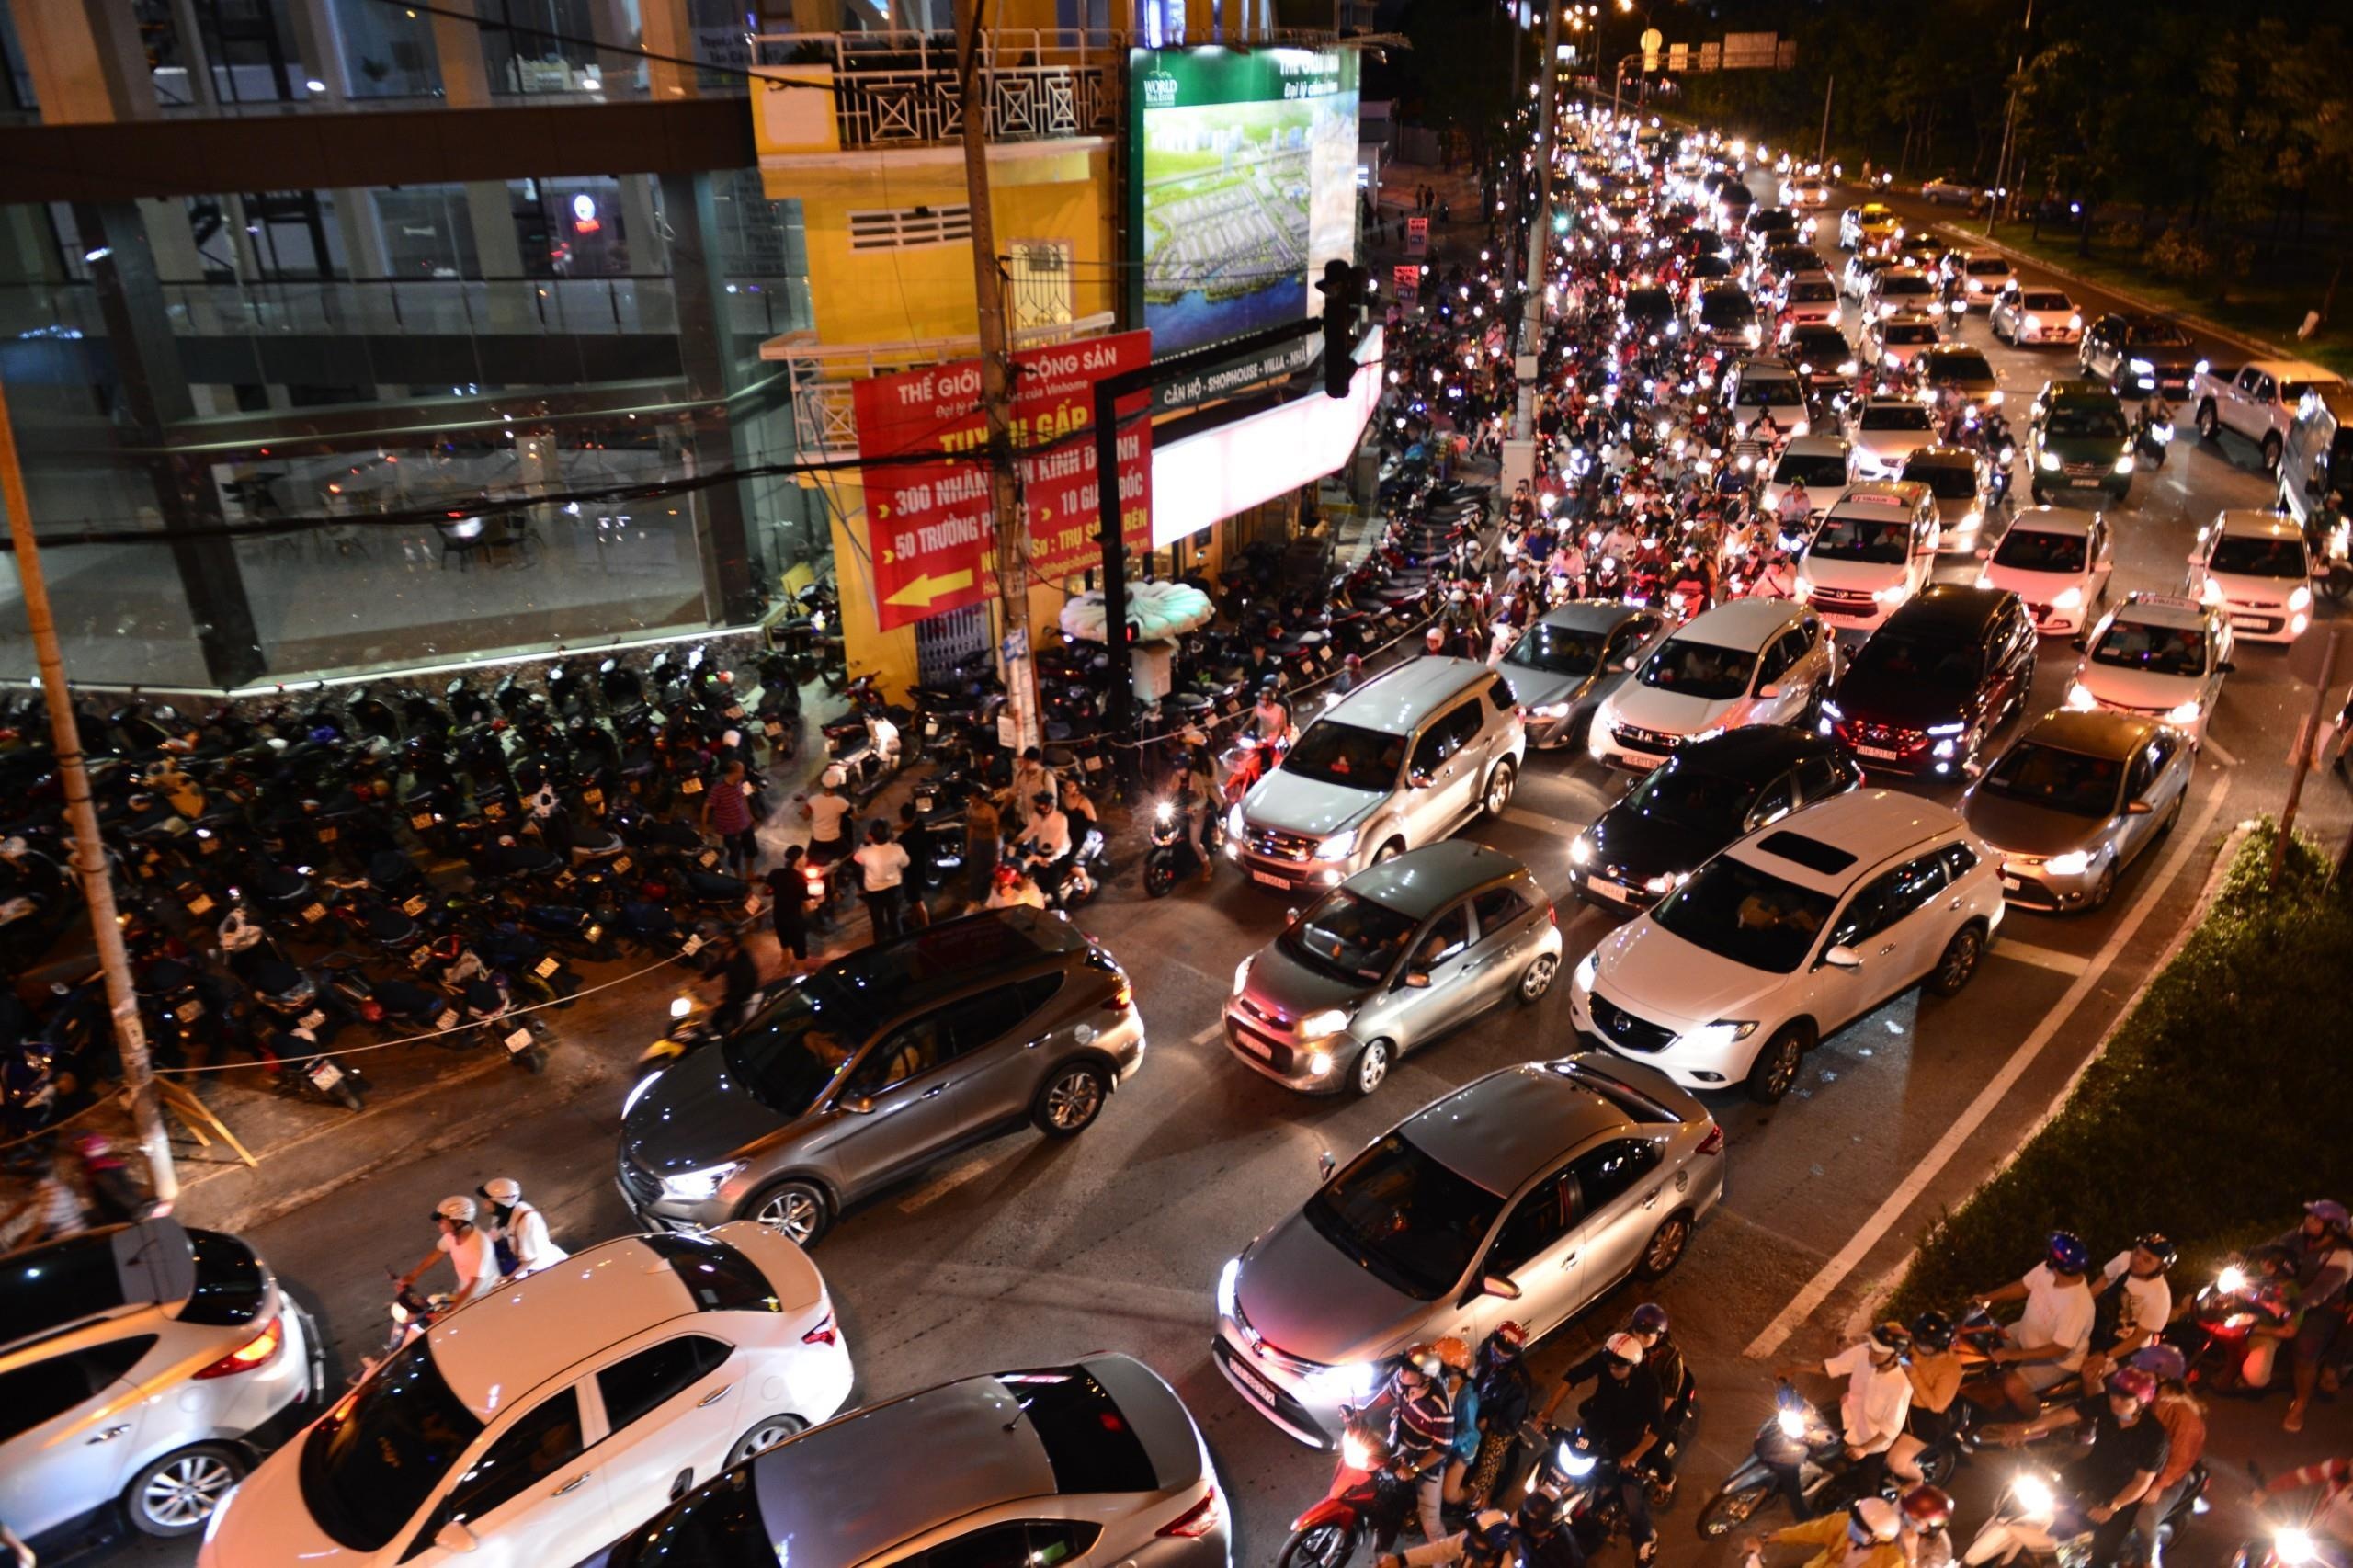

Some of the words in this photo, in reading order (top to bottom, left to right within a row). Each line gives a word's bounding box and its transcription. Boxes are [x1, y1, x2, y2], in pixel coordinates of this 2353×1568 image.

[1143, 79, 1177, 96] WORLD
[1083, 344, 1117, 369] SẢN
[1208, 363, 1258, 392] SHOPHOUSE
[1264, 355, 1285, 374] VILLA
[895, 484, 932, 516] 300
[1039, 449, 1080, 481] KINH
[895, 532, 915, 560] 50
[1061, 489, 1078, 515] 10
